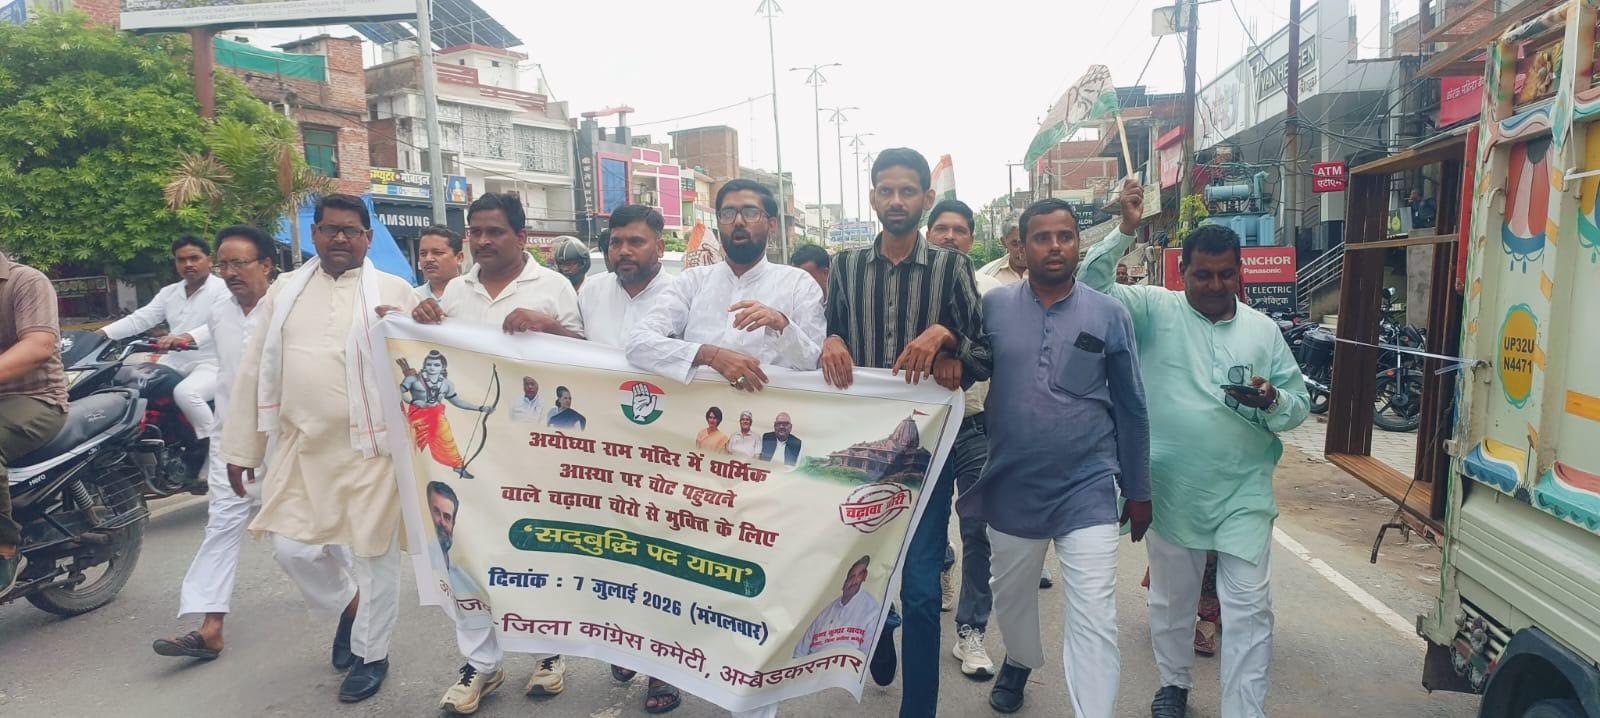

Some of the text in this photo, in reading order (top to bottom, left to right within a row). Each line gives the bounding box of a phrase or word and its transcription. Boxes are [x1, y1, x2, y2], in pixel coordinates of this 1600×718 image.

[1277, 45, 1314, 80] HEEN
[1317, 166, 1342, 177] ATM
[378, 213, 430, 227] AMSUNG
[1240, 255, 1291, 266] ANCHOR
[1244, 267, 1281, 275] Panasonic
[1252, 286, 1292, 294] ELECTRIC
[1504, 336, 1535, 354] UP32U
[1503, 356, 1532, 374] N4471
[602, 441, 633, 459] राम
[638, 445, 681, 467] मंदिर
[687, 452, 704, 472] में
[560, 463, 614, 484] आस्था
[620, 471, 643, 488] पर
[649, 474, 678, 496] चोट
[501, 484, 779, 547] वाले चढ़ावा चोरो से मुक्ति के लिए
[646, 543, 681, 566] पद
[488, 567, 549, 588] दिनांक
[573, 576, 584, 591] 7
[591, 578, 638, 603] जुलाई
[643, 591, 682, 617] 2026
[690, 602, 769, 646] (मंगलवार)
[501, 613, 572, 636] जिला
[580, 622, 645, 650] कांग्रेस
[719, 654, 863, 689] अम्बेडकरनगर
